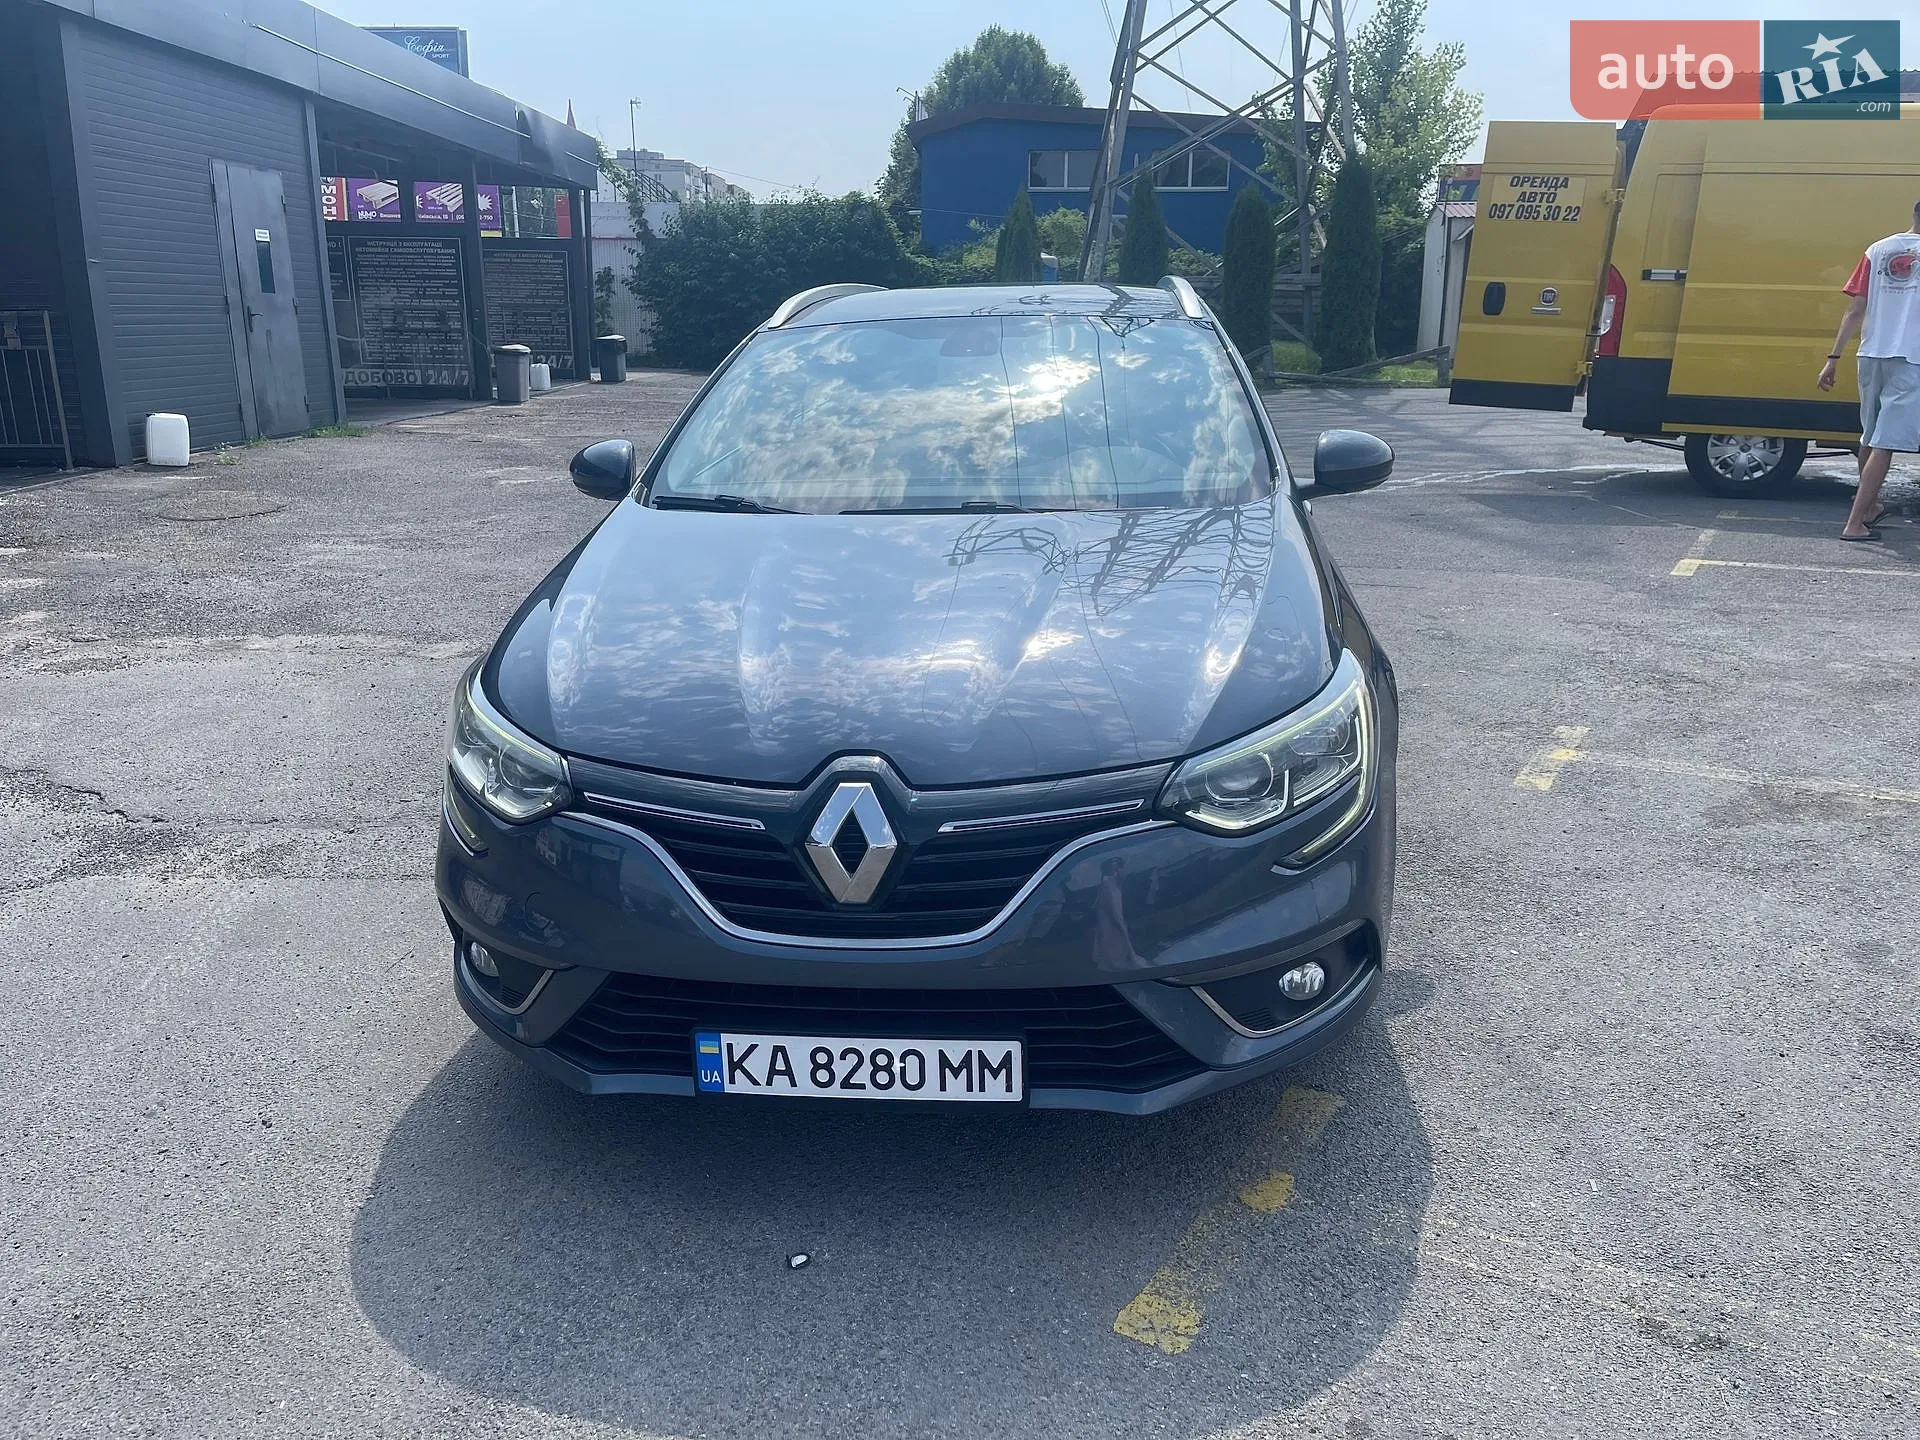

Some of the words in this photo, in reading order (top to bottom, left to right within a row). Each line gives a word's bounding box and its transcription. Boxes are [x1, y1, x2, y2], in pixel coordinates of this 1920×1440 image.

[1509, 175, 1569, 191] ОРЕНДА
[1516, 191, 1558, 204] АВТО
[1488, 203, 1514, 219] 097
[1515, 204, 1541, 220] 095
[1542, 205, 1561, 221] 30
[1562, 206, 1581, 222] 22
[725, 1042, 798, 1088] KA
[809, 1046, 926, 1092] 8280
[938, 1048, 1013, 1093] MM
[701, 1069, 721, 1084] UA
